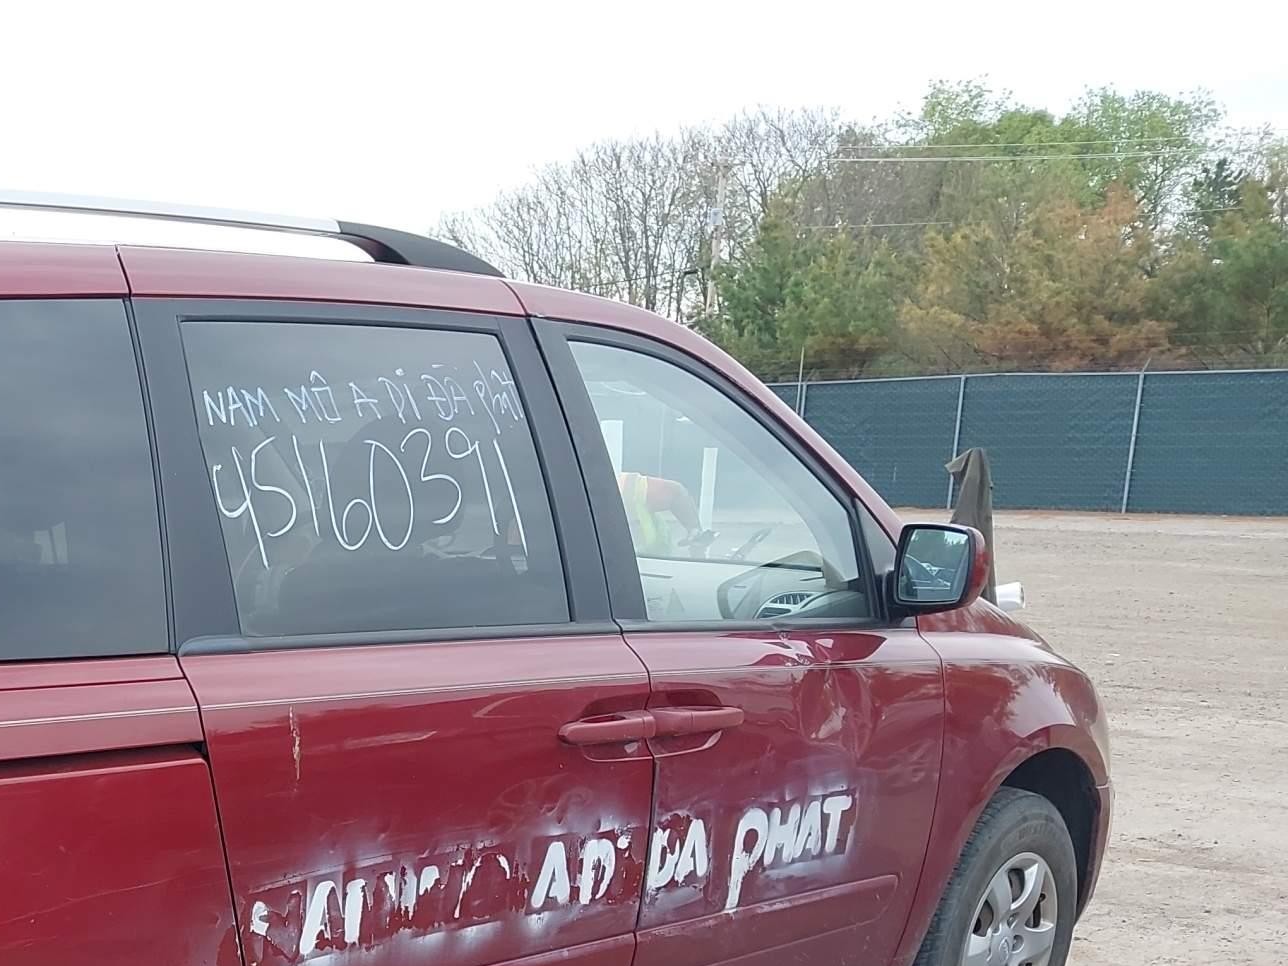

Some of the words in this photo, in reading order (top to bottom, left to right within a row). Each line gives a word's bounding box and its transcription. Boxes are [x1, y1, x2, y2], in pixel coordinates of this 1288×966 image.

[203, 385, 280, 427] NAM
[348, 381, 382, 419] A
[212, 427, 528, 571] 45160391
[725, 795, 853, 914] PHAT
